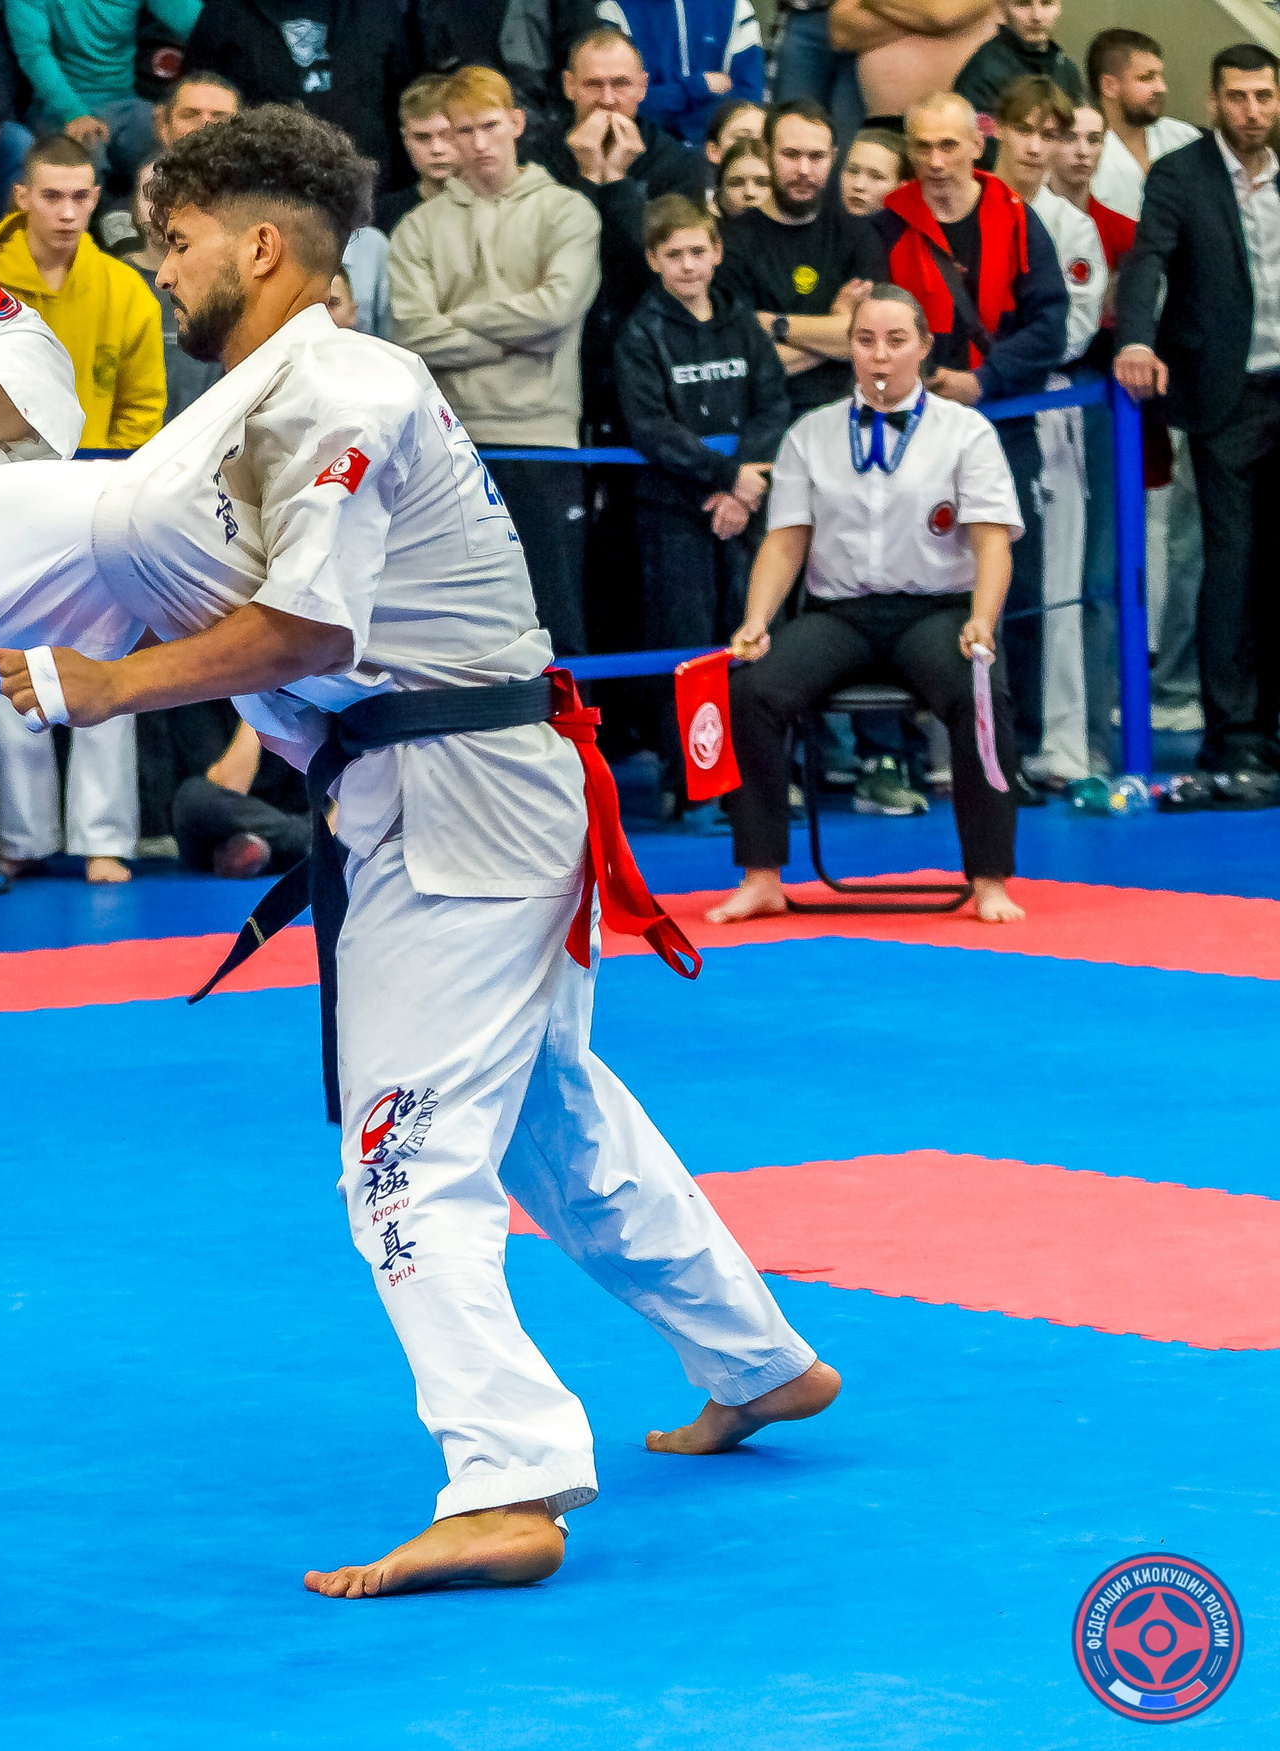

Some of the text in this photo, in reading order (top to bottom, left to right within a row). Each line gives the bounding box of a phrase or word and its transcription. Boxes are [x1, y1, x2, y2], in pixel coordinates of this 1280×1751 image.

[372, 1197, 410, 1228] KYOKU
[379, 1220, 416, 1271] 真
[388, 1263, 416, 1288] SHIN
